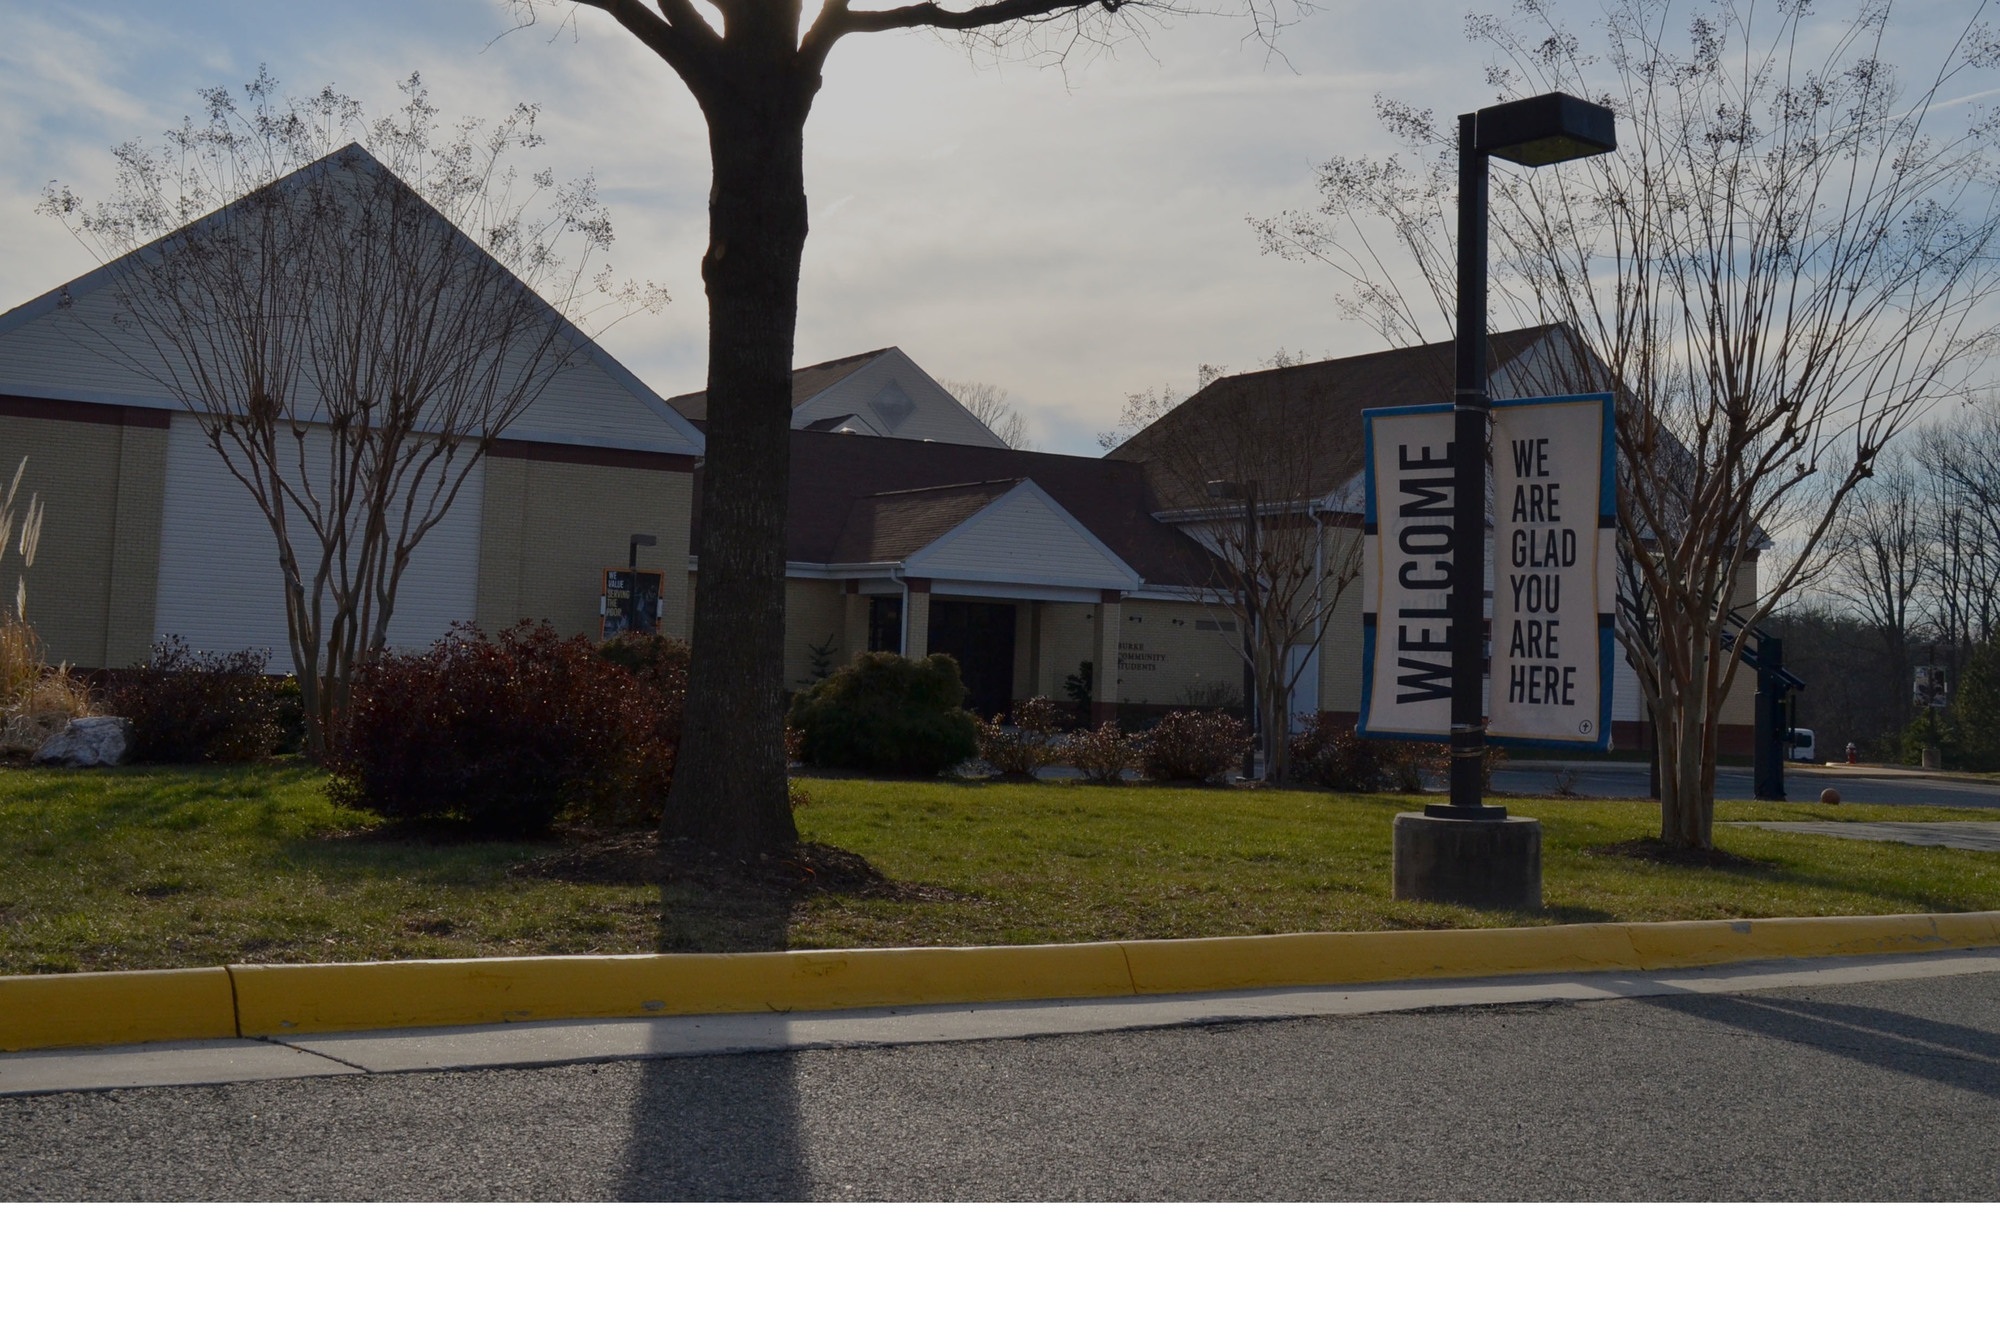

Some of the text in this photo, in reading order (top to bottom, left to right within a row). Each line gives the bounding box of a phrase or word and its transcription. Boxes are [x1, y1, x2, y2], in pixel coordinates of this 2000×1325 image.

[1512, 439, 1549, 477] WE
[1512, 484, 1561, 522] ARE
[1512, 529, 1576, 568] GLAD
[608, 571, 617, 580] WE
[608, 580, 624, 588] VALUE
[1396, 442, 1456, 704] WELCOME
[606, 607, 623, 617] POOR
[607, 589, 631, 599] SERVING
[607, 599, 618, 608] THE
[1510, 574, 1560, 613] YOU
[1509, 620, 1559, 659] ARE
[1509, 665, 1577, 705] HERE
